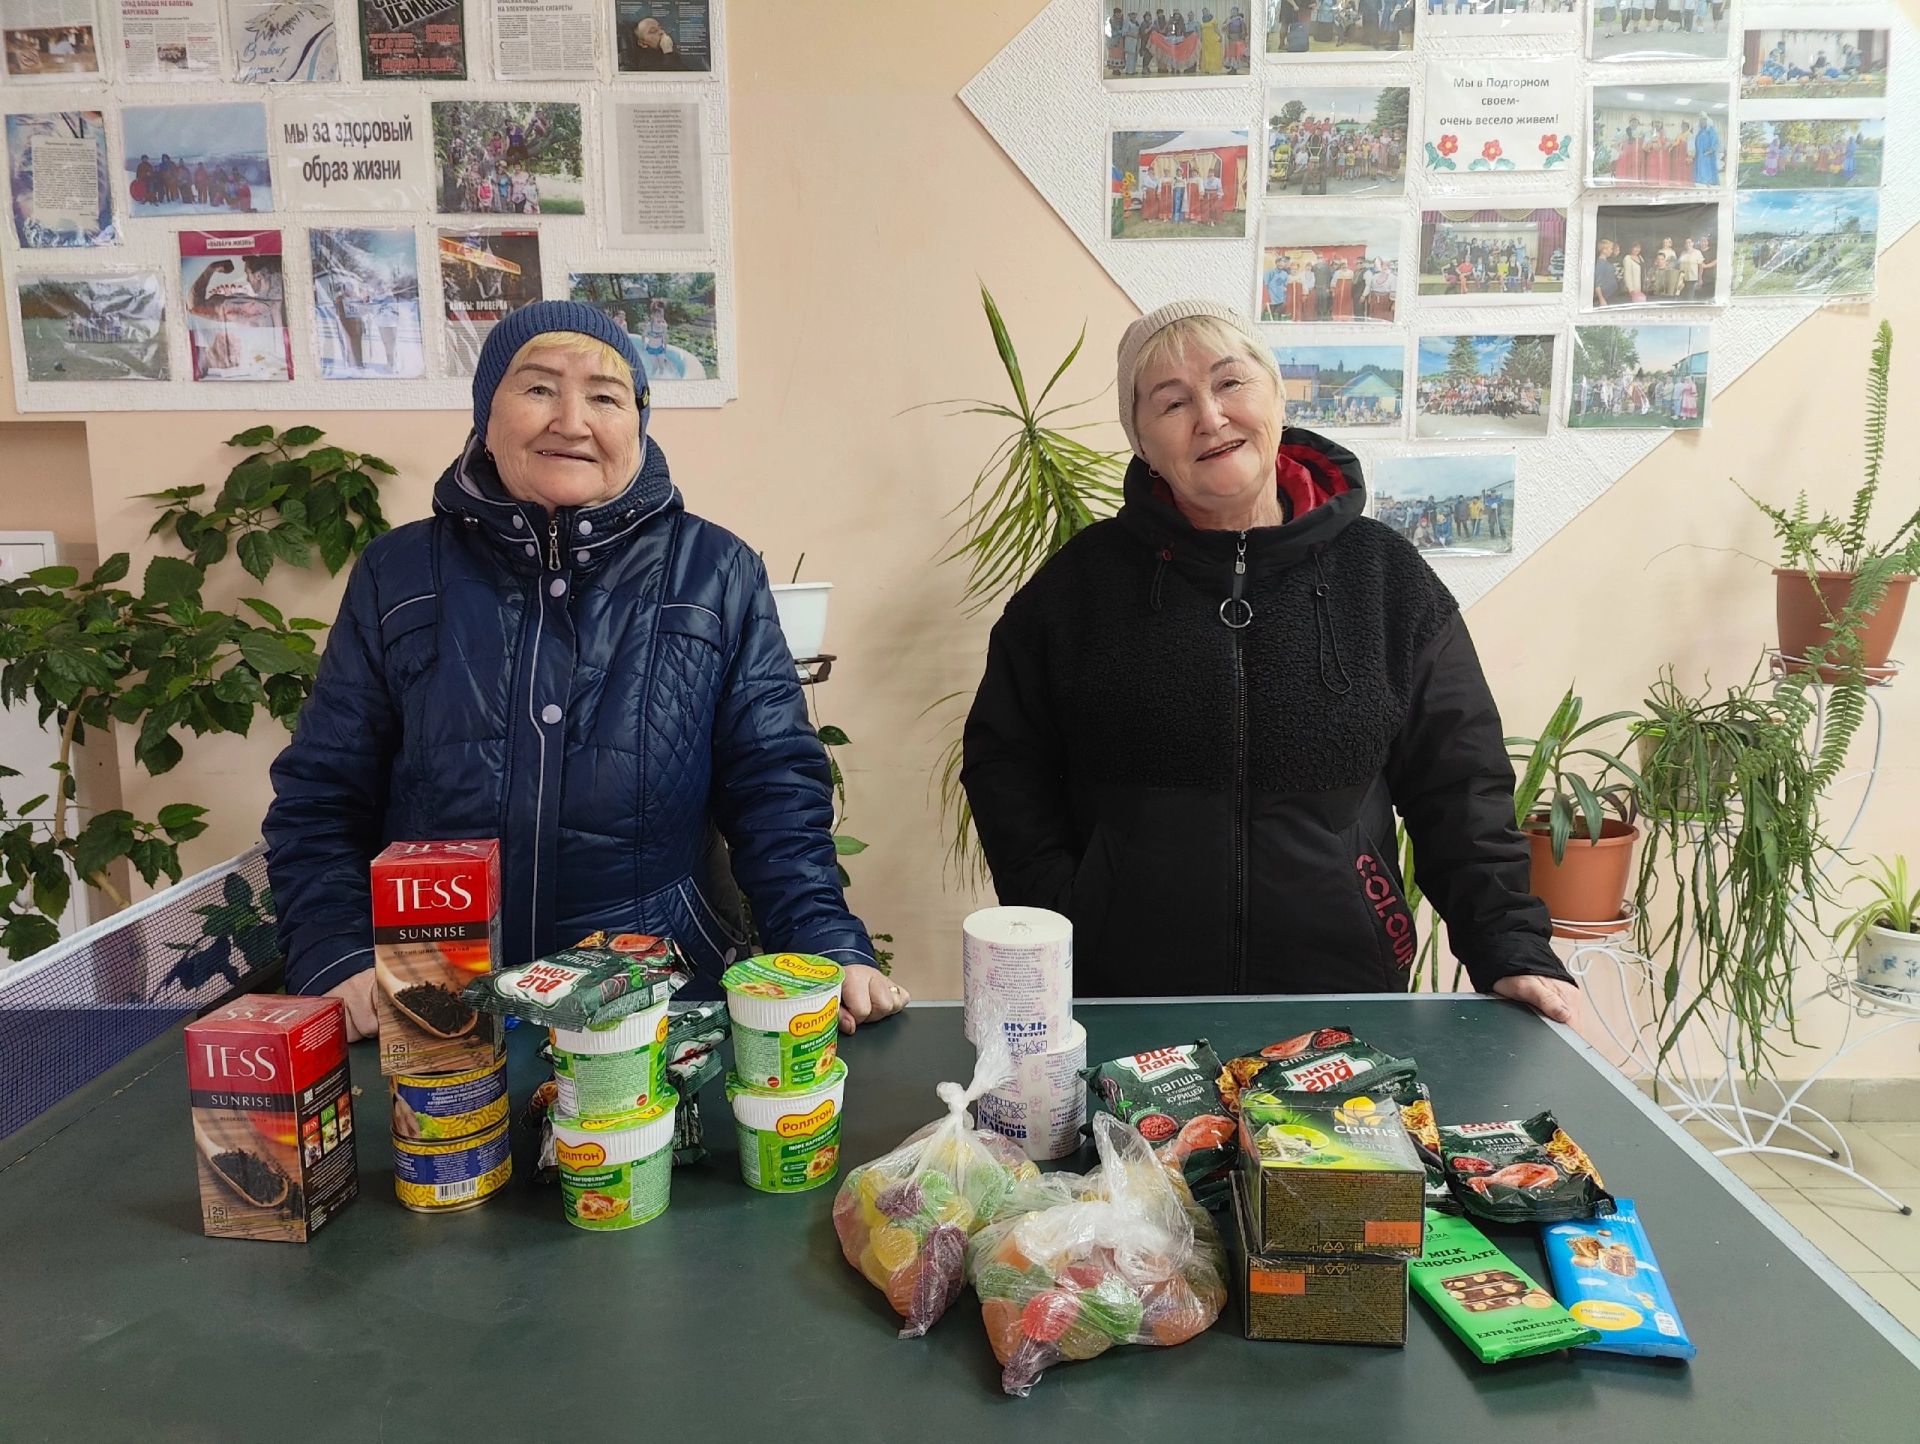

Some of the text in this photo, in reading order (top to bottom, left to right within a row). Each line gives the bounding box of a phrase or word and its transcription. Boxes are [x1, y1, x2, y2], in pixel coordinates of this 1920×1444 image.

[383, 0, 460, 30] УБИВА
[1453, 77, 1550, 89] Мы в Подгорном
[1481, 97, 1520, 106] своем-
[1440, 113, 1559, 126] очень весело живем!
[312, 122, 331, 143] за
[335, 114, 413, 149] здоровый
[302, 154, 402, 188] образ жизни
[386, 874, 472, 913] TESS
[399, 925, 466, 940] SUNRISE
[392, 1043, 406, 1053] 25
[198, 1043, 276, 1082] TESS
[211, 1094, 272, 1108] SUNRISE
[1166, 1085, 1205, 1104] КУРИЦЕЙ
[1334, 1125, 1399, 1138] CURTIS
[212, 1206, 224, 1216] 25
[1412, 1249, 1500, 1268] CHOCOLATE
[1428, 1247, 1466, 1259] MILK
[1475, 1317, 1576, 1340] EXTRA HAZELNUTS
